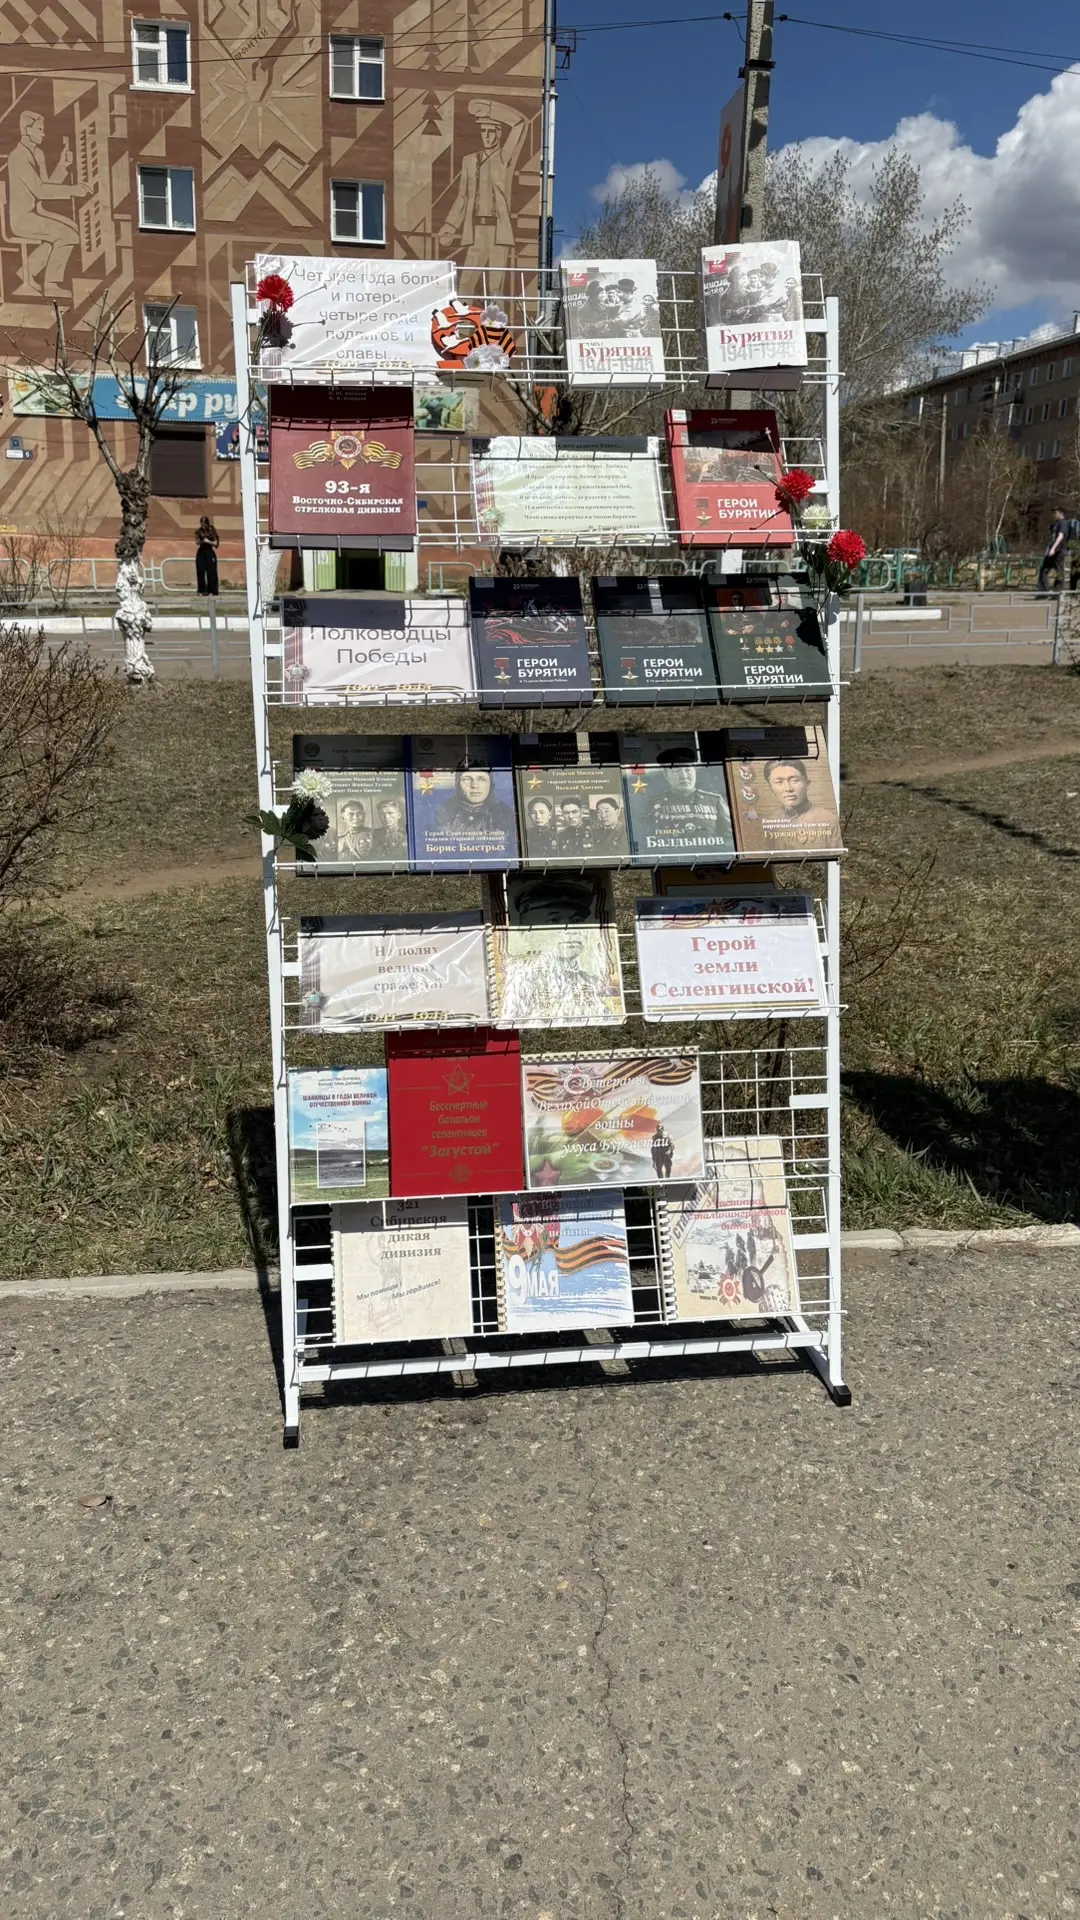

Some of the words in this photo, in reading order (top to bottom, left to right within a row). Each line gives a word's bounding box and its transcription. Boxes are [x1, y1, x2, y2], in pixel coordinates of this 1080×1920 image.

[331, 294, 340, 302] и
[346, 293, 405, 305] потерь,
[319, 310, 378, 325] четыре
[405, 331, 414, 342] и
[720, 328, 793, 348] Бурятия
[579, 341, 652, 363] Бурятия
[325, 480, 371, 494] 93-я
[717, 498, 757, 508] ГЕРОИ
[719, 509, 776, 519] БУРЯТИИ
[311, 626, 450, 643] Полководцы
[337, 649, 427, 666] Победы
[517, 658, 558, 668] ГЕРОИ
[643, 658, 684, 668] ГЕРОИ
[518, 667, 577, 678] БУРЯТИИ
[645, 667, 703, 678] БУРЯТИИ
[744, 665, 784, 675] ГЕРОИ
[746, 674, 803, 685] БУРЯТИИ
[646, 836, 724, 848] Балдынов
[426, 844, 457, 854] Борис
[459, 843, 506, 853] Быстрых
[399, 946, 438, 956] полях
[692, 936, 756, 955] Герой
[694, 960, 758, 974] земли
[650, 978, 814, 998] Селенгинской!
[537, 1099, 591, 1113] Великой
[438, 1115, 480, 1124] батальон
[595, 1118, 634, 1130] войны
[562, 1142, 597, 1157] улуса
[397, 1200, 419, 1211] 321
[388, 1233, 430, 1244] дикая
[381, 1248, 441, 1260] дивизия
